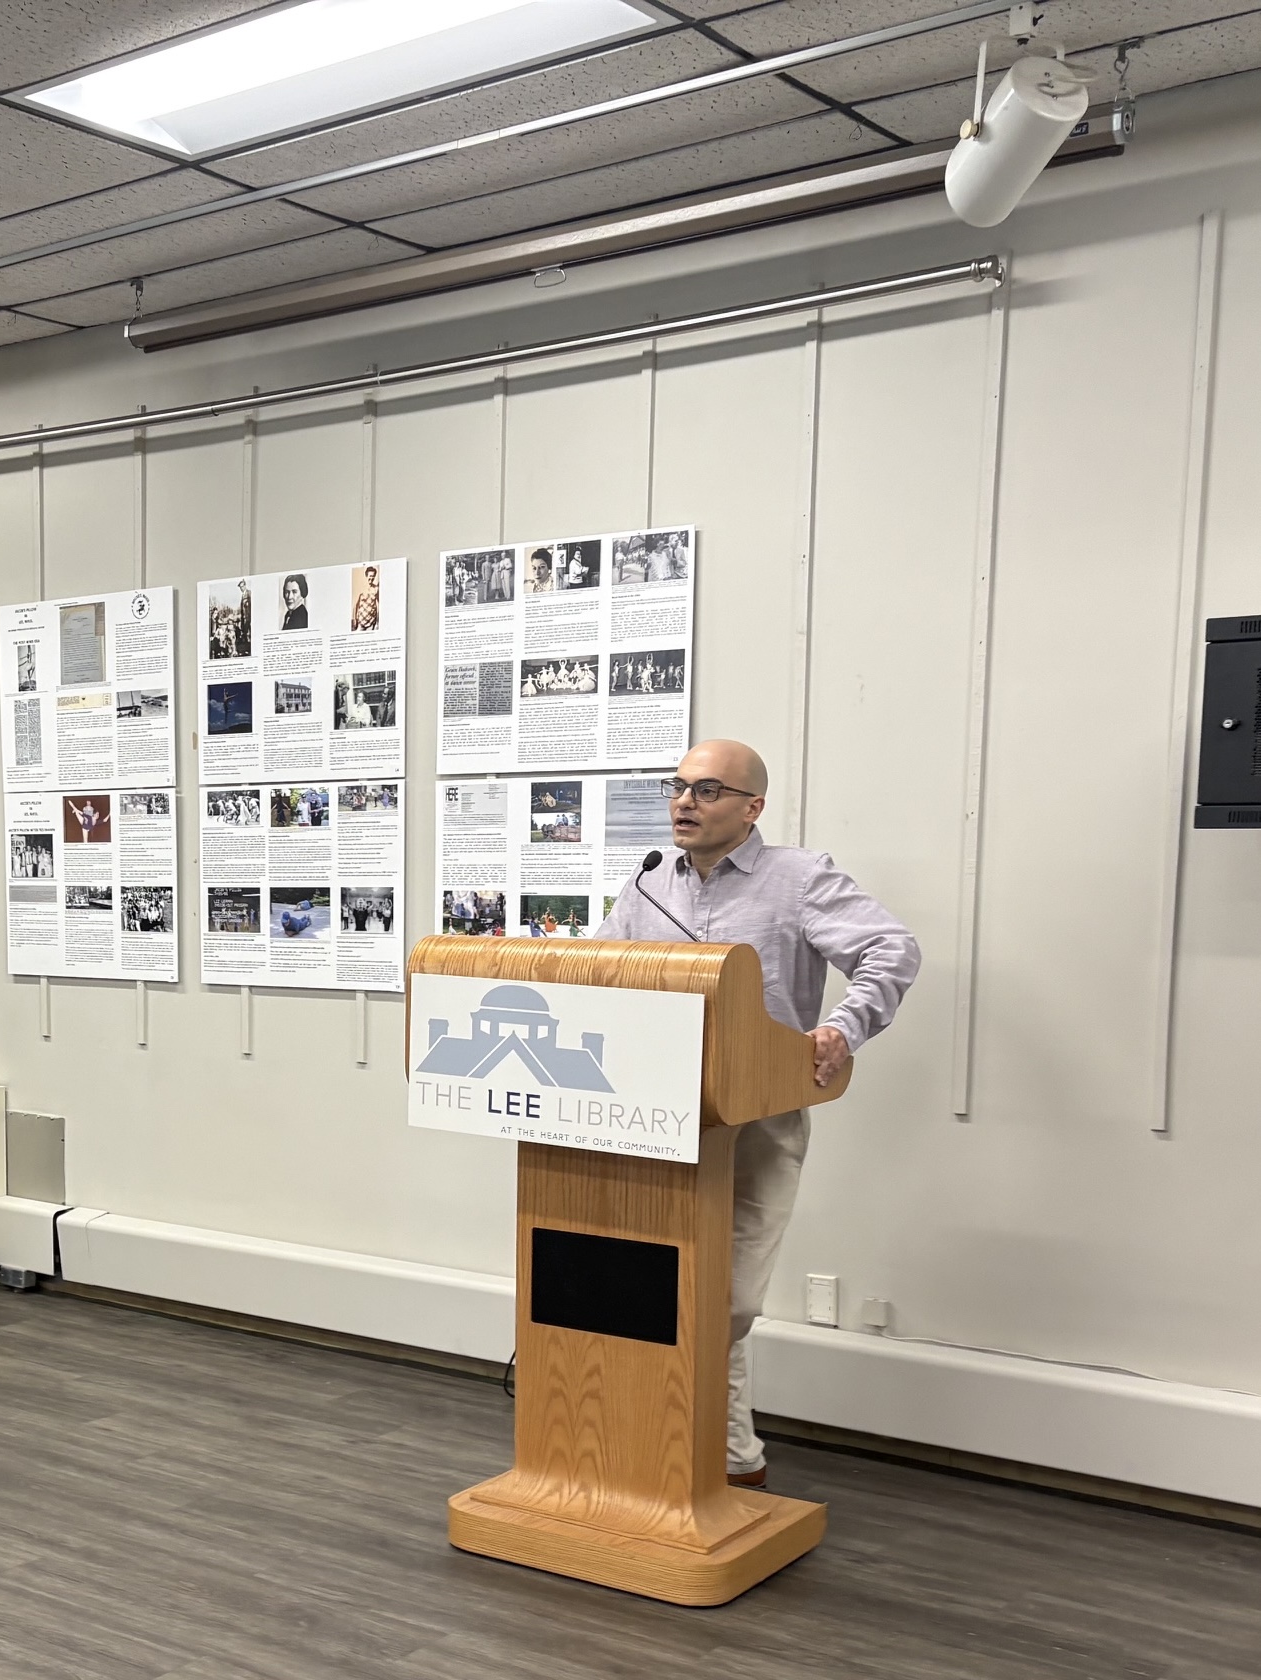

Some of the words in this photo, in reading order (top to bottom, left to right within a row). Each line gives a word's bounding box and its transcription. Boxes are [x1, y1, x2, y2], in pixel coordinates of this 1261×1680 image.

[416, 1081, 471, 1110] THE
[488, 1089, 540, 1119] LEE
[558, 1097, 690, 1136] LIBRARY
[500, 1126, 512, 1135] AT
[517, 1128, 535, 1137] THE
[540, 1131, 570, 1142] HEART
[575, 1135, 588, 1144] OF
[593, 1137, 613, 1148] OUR
[618, 1140, 681, 1157] COMMUNITY.
